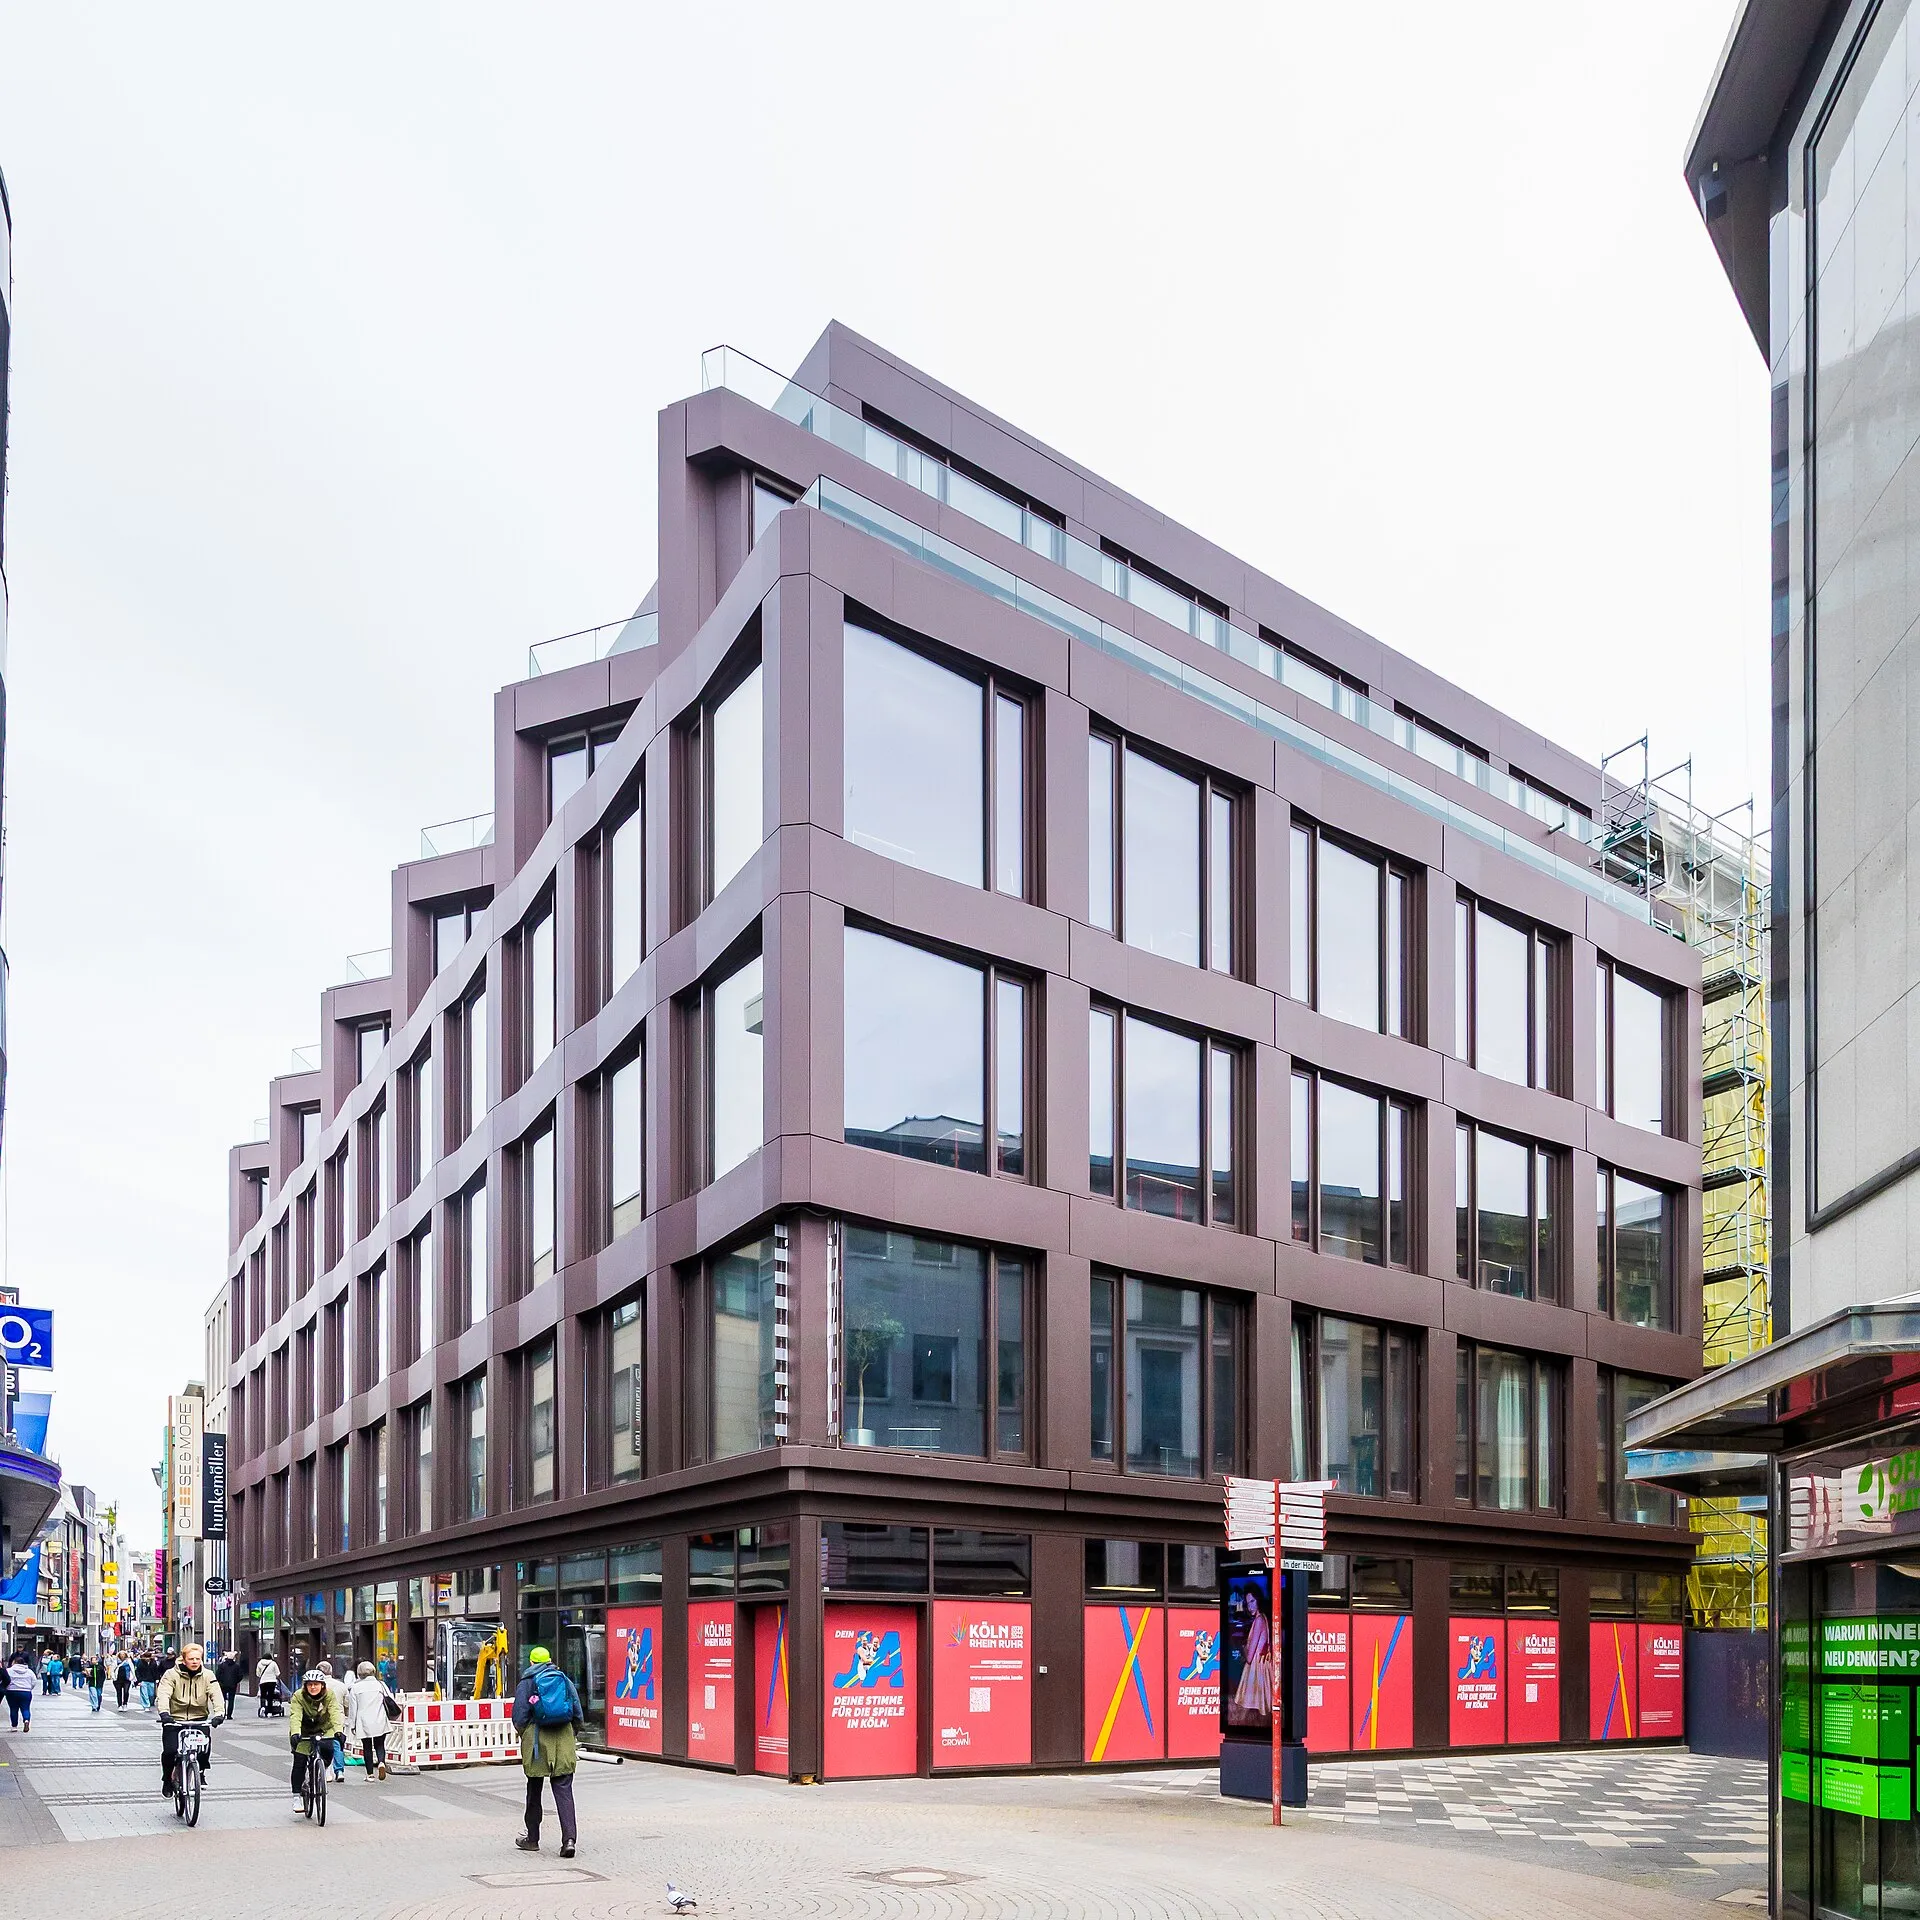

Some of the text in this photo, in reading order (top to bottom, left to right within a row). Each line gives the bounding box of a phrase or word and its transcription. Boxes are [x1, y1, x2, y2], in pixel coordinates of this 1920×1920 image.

[179, 1403, 191, 1528] CHEESE & MORE
[208, 1442, 224, 1531] hunkemöller
[1283, 1560, 1289, 1568] In
[704, 1621, 724, 1637] KÖLN
[835, 1630, 854, 1638] DEIN
[969, 1621, 1009, 1638] KÖLN
[1825, 1625, 1866, 1641] WARUM
[1308, 1630, 1335, 1644] KÖLN
[1525, 1634, 1548, 1647] KÖLN
[969, 1639, 1024, 1648] RHEIN RUHR
[1654, 1637, 1673, 1649] KÖLN
[1825, 1650, 1920, 1667] NEU DENKEN?
[1179, 1686, 1220, 1695] DEINE STIM
[1457, 1692, 1468, 1700] FÜR
[833, 1695, 904, 1705] DEINE STIMME
[1178, 1696, 1193, 1705] FÜR
[1194, 1697, 1206, 1705] DIE
[832, 1706, 905, 1717] FÜR DIE SPIELE
[1189, 1707, 1198, 1715] IN
[847, 1717, 890, 1728] IN KÖLN.
[942, 1738, 969, 1746] CROWN
